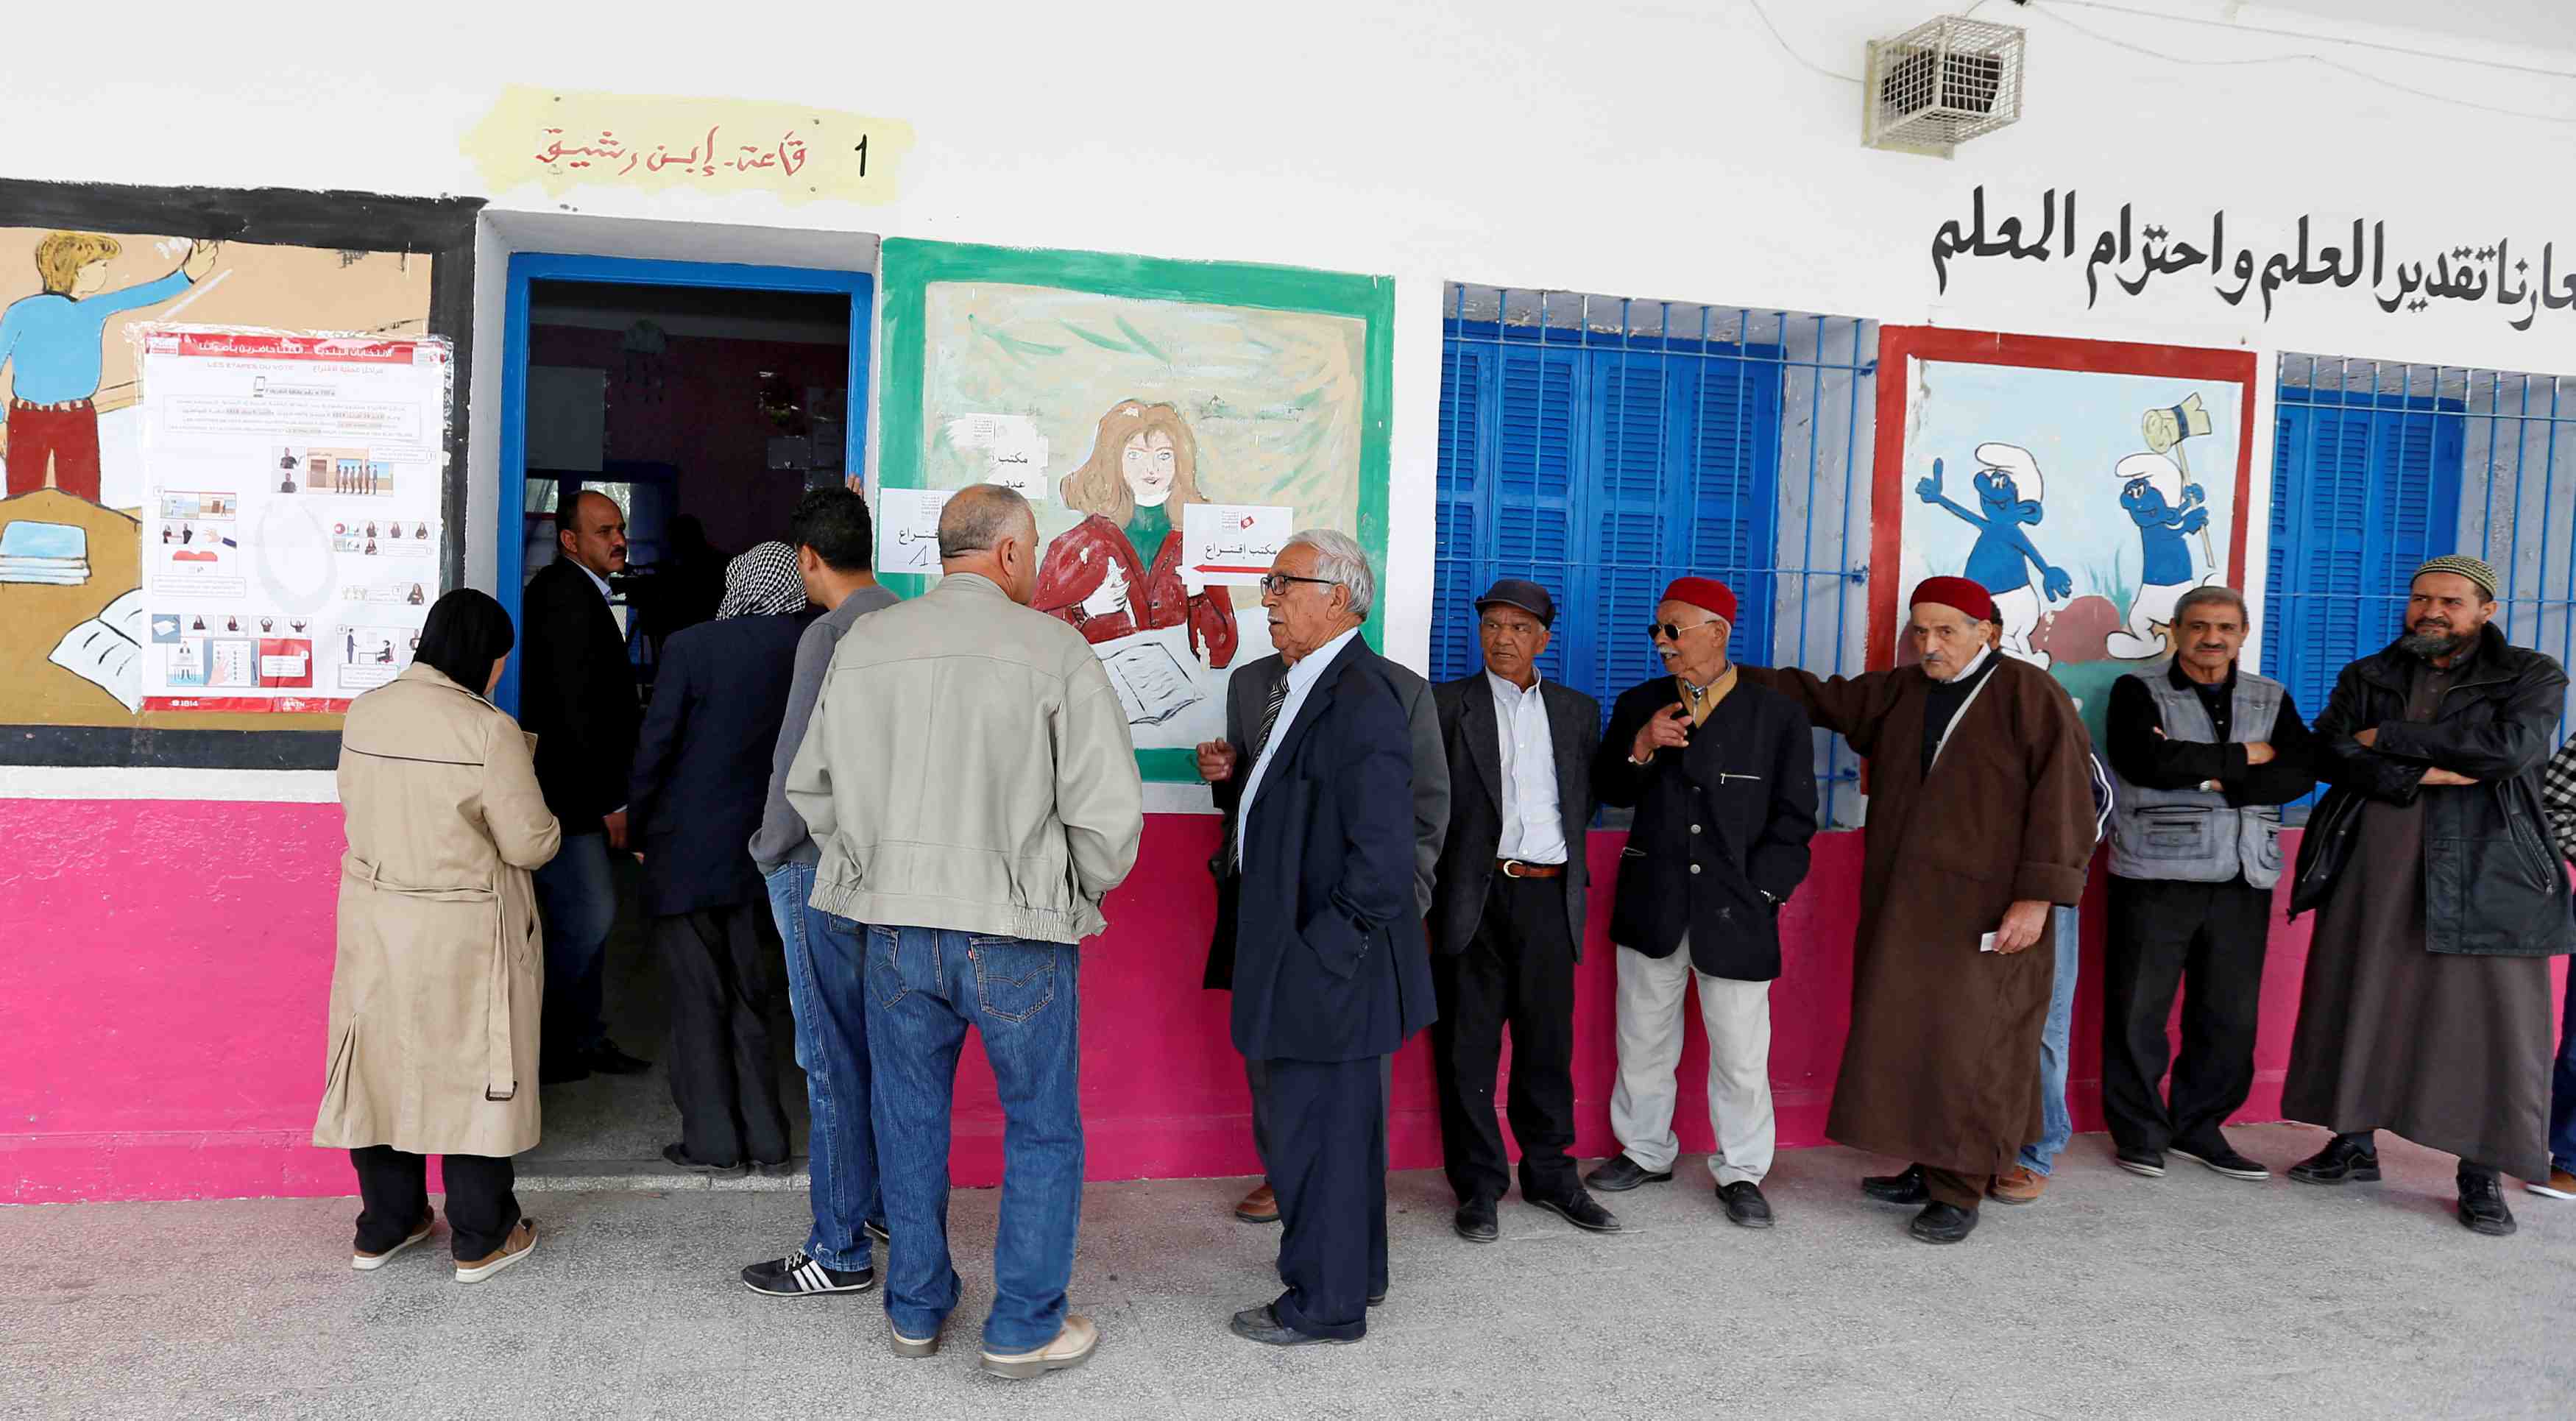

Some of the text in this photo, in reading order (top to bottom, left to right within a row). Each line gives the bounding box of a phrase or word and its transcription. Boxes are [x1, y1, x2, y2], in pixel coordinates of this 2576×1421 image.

[535, 128, 637, 176] رشيق
[854, 133, 868, 177] 1
[1931, 185, 2076, 296] المعلم
[2260, 214, 2384, 322] العلم
[2376, 246, 2497, 314] تقدير
[998, 452, 1028, 466] مكتب
[1249, 543, 1277, 557] مكتب
